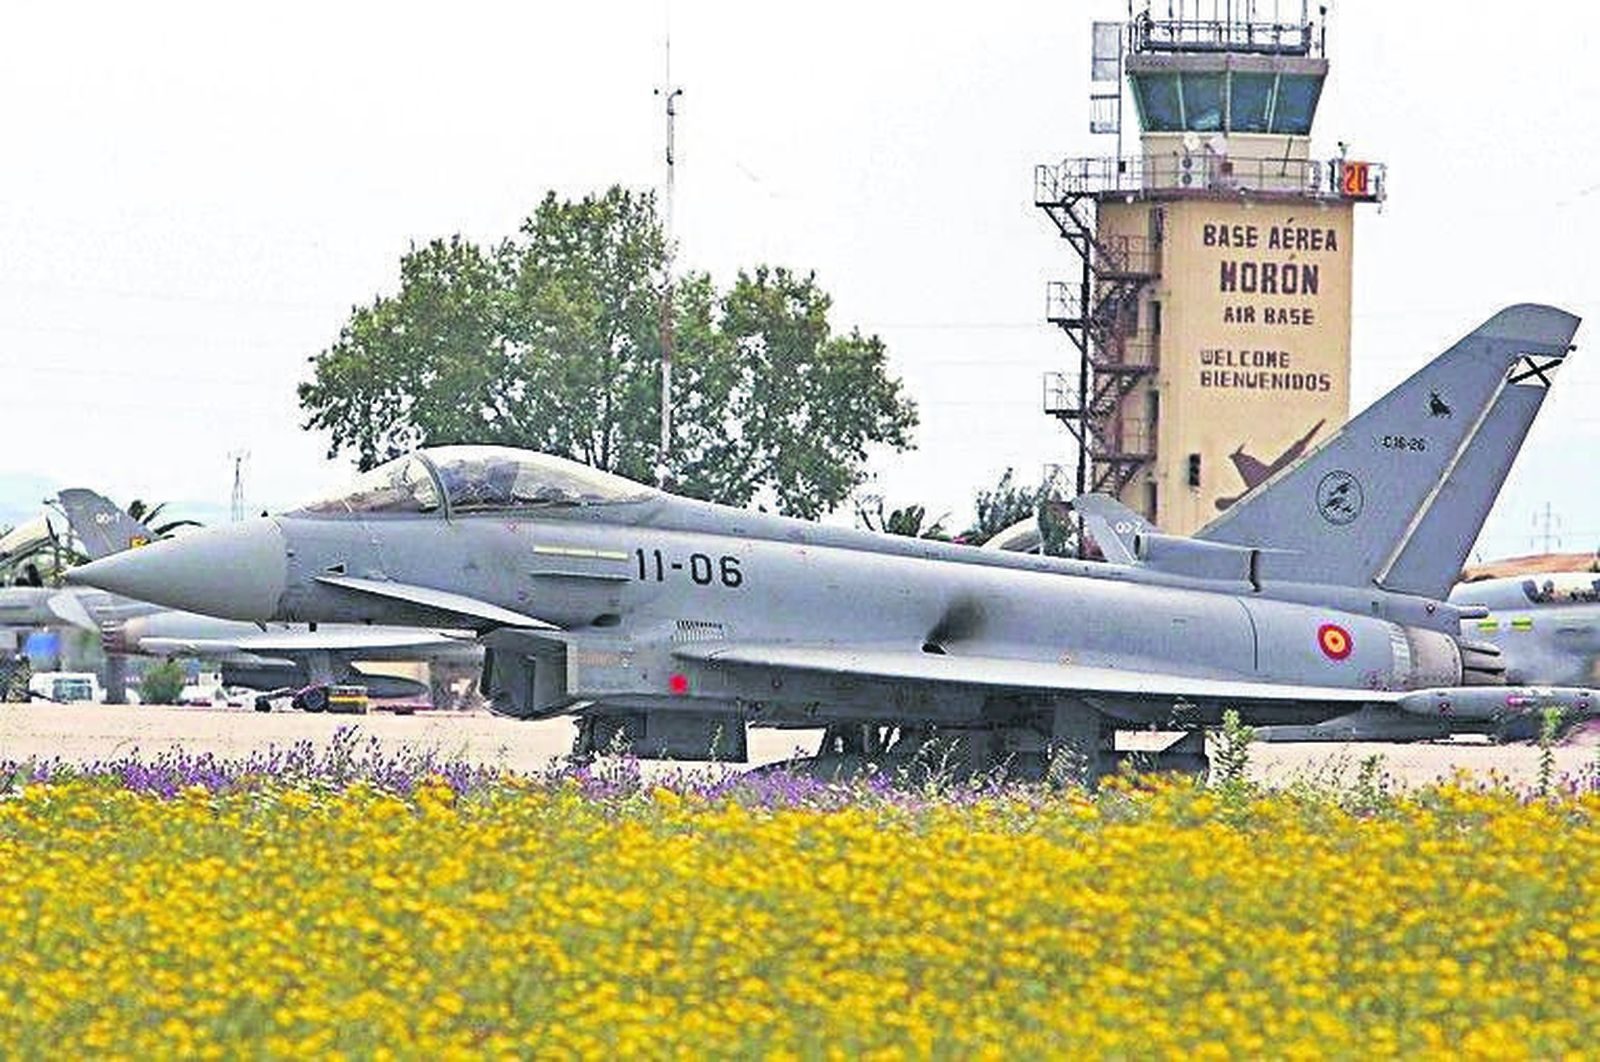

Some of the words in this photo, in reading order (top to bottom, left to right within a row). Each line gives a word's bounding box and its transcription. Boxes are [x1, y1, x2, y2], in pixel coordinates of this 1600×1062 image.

[1345, 164, 1368, 193] 20
[1203, 223, 1258, 249] BASE
[1268, 217, 1338, 252] AÉREA
[1220, 254, 1319, 295] MORÓN
[1223, 305, 1256, 324] AIR
[1264, 307, 1315, 326] BASE
[1200, 349, 1290, 369] WELCOME
[1200, 370, 1332, 393] BIENVENIDOS
[635, 547, 743, 588] 11-06
